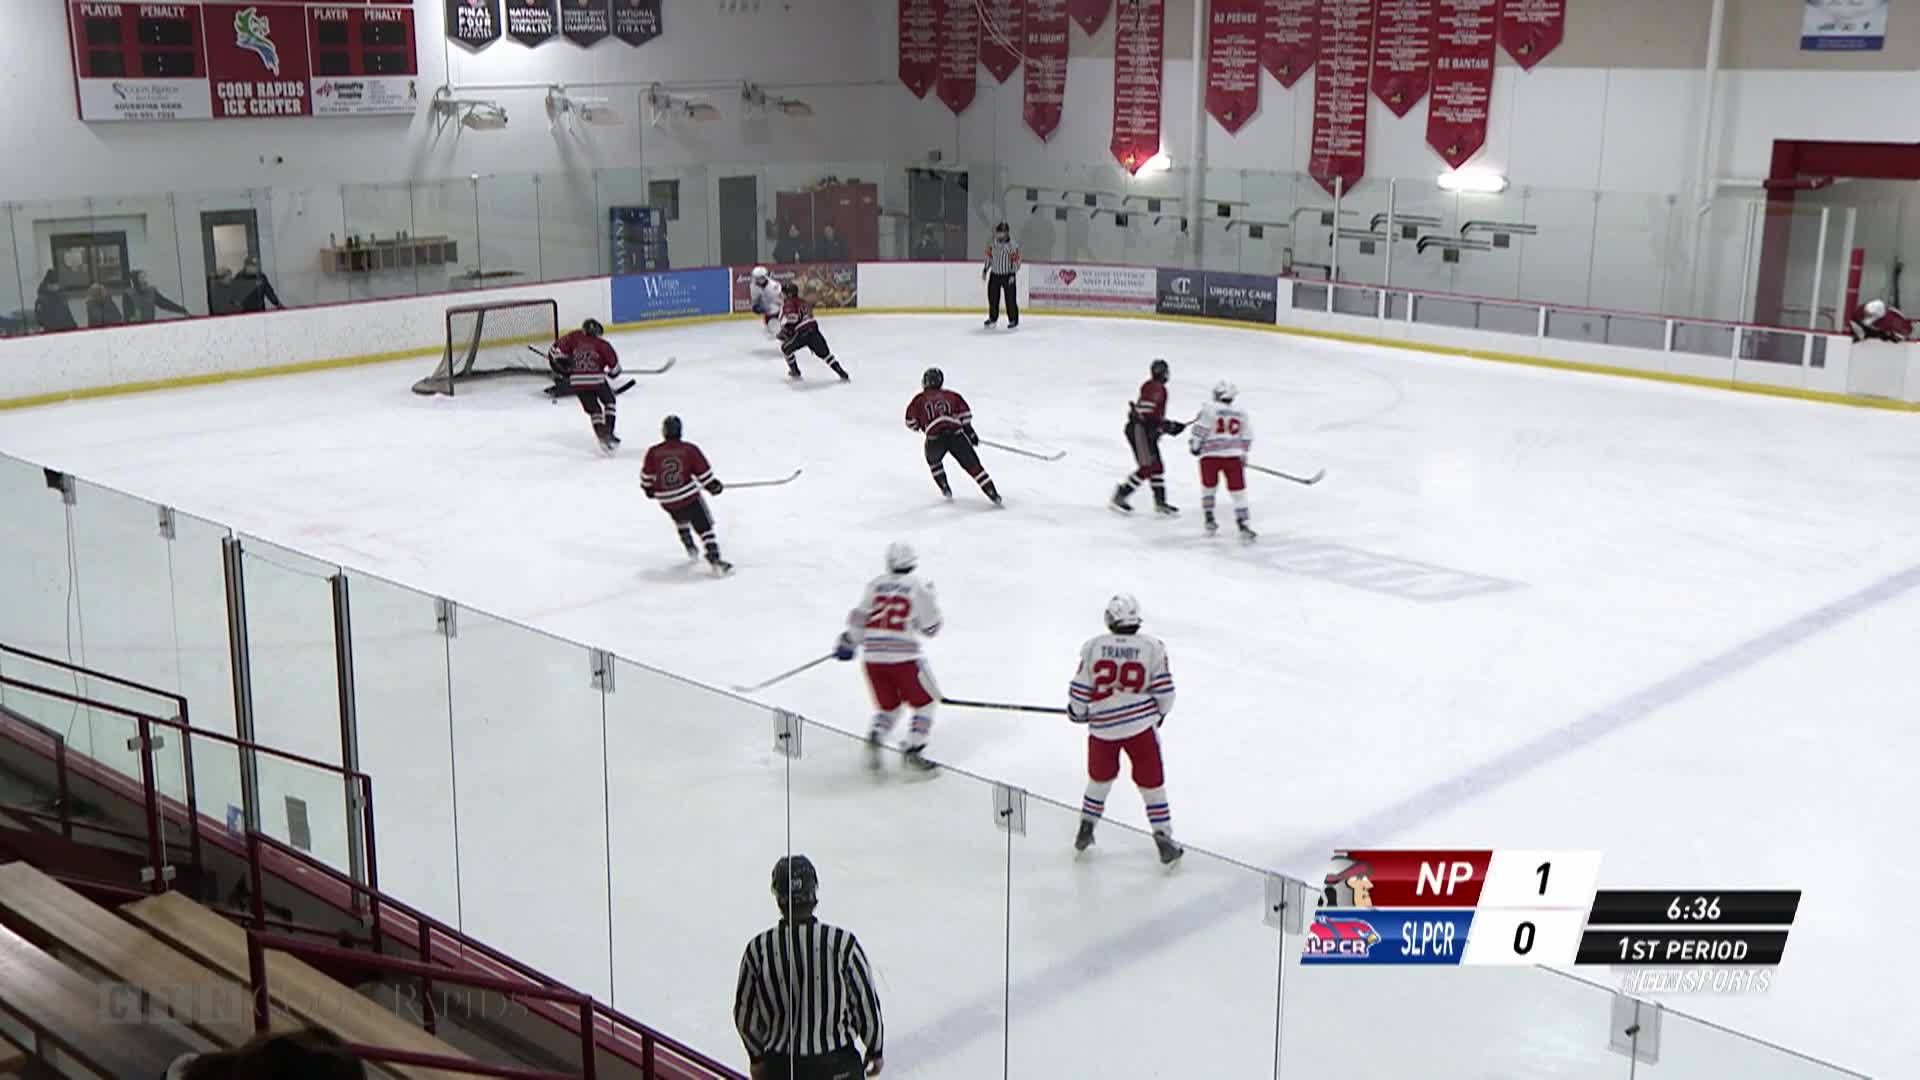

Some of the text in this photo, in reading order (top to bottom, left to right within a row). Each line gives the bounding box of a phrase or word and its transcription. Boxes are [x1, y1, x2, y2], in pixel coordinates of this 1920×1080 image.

[81, 5, 185, 17] PLAYER PENALTY
[314, 10, 401, 20] PLAYER PENALTY
[458, 7, 490, 17] FINAL
[509, 8, 550, 16] NATIONAL
[458, 17, 491, 27] FOUR
[511, 24, 552, 33] FINALIST
[1452, 58, 1489, 69] BANTAM
[217, 82, 304, 97] COON RAPIDS
[224, 100, 301, 115] ICE CENTER
[1209, 287, 1273, 300] URGENT CARE
[662, 456, 684, 488] 2
[864, 594, 911, 632] 22
[1089, 658, 1147, 702] 29
